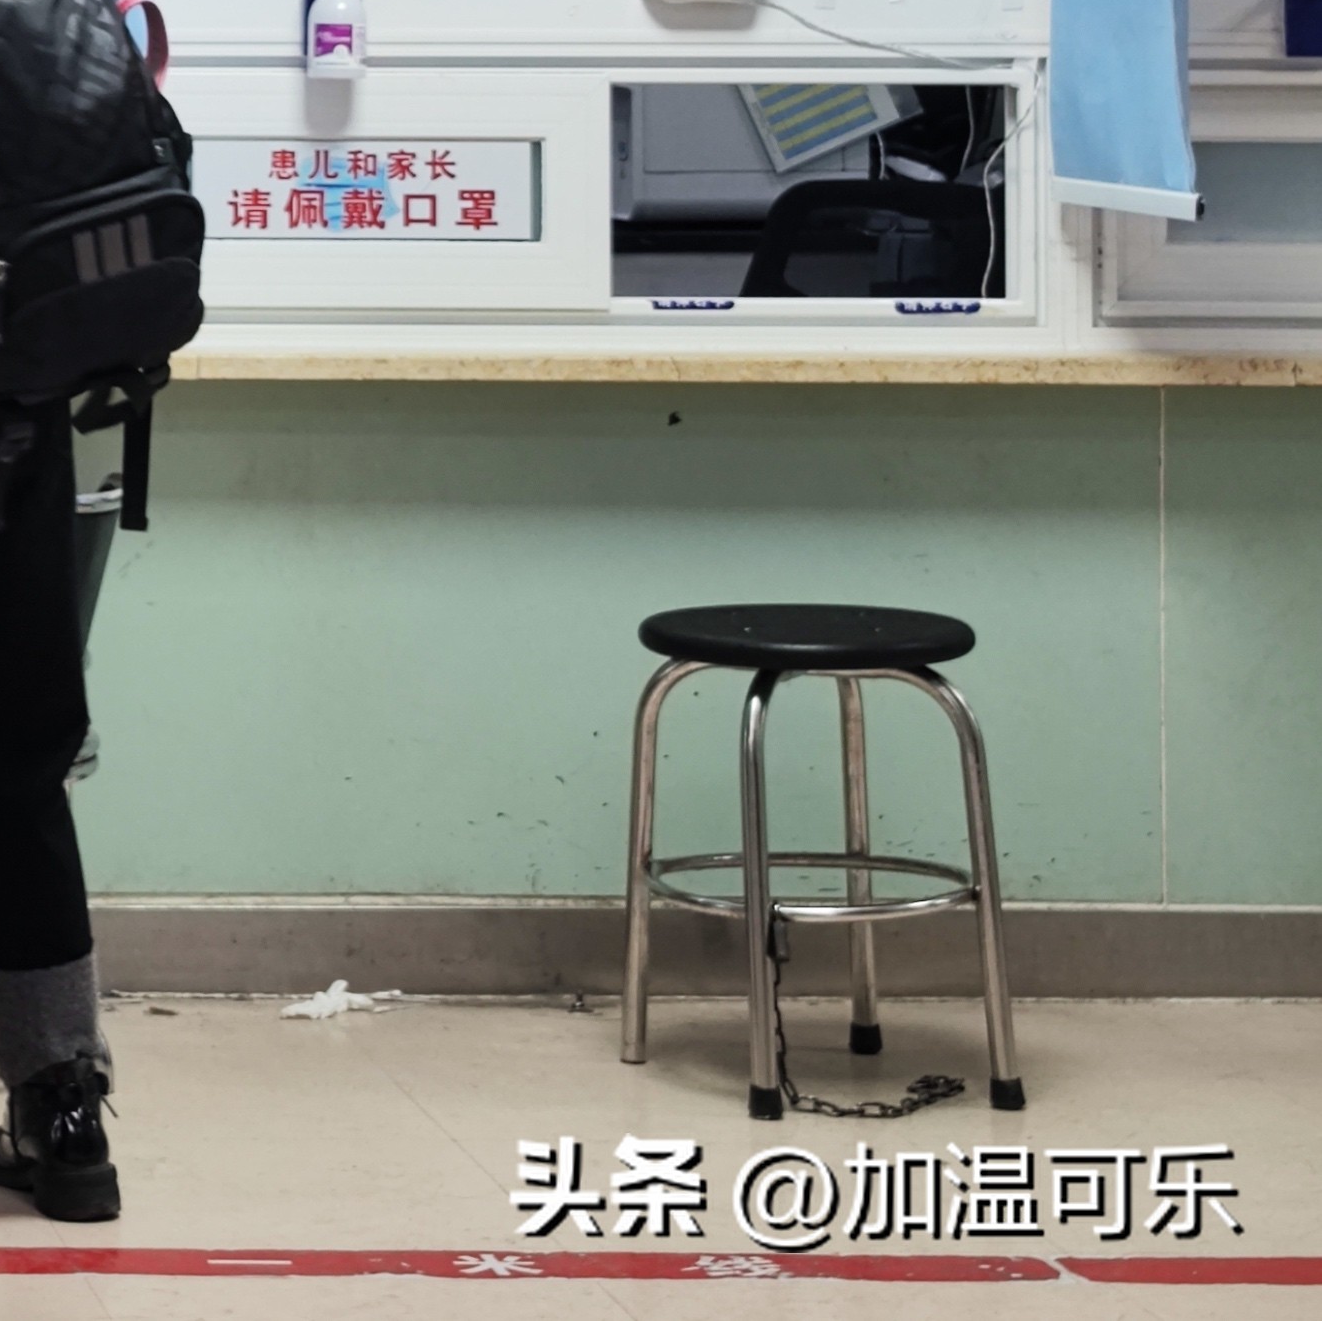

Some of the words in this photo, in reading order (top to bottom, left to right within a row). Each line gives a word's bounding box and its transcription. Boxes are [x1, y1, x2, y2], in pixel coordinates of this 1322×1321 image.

[268, 149, 456, 180] 患儿和家长
[227, 189, 499, 230] 请佩戴口罩
